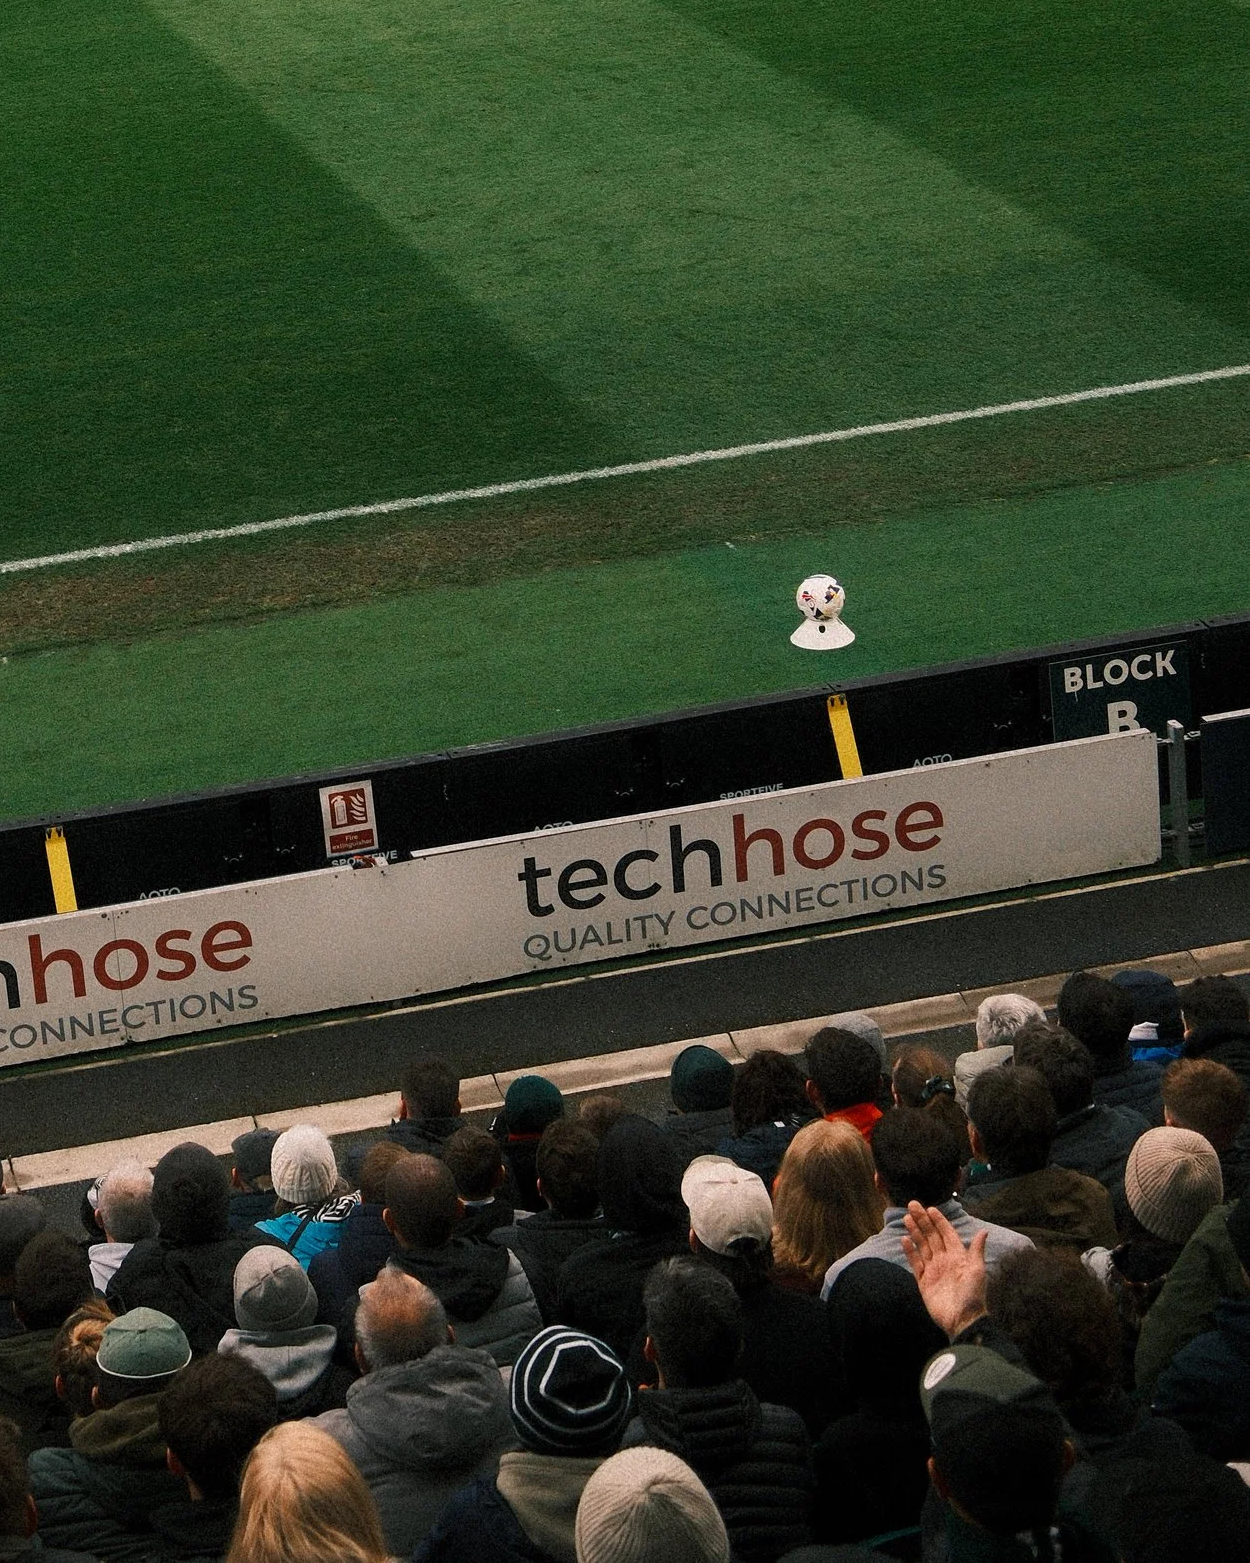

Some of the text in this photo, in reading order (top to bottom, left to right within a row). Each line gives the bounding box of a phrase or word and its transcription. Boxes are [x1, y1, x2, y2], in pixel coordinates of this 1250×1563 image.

[1064, 649, 1177, 693] BLOCK
[1107, 700, 1141, 734] B
[332, 838, 373, 850] extinguisher
[516, 800, 945, 918] techhose
[523, 864, 947, 963] QUALITY CONNECTIONS
